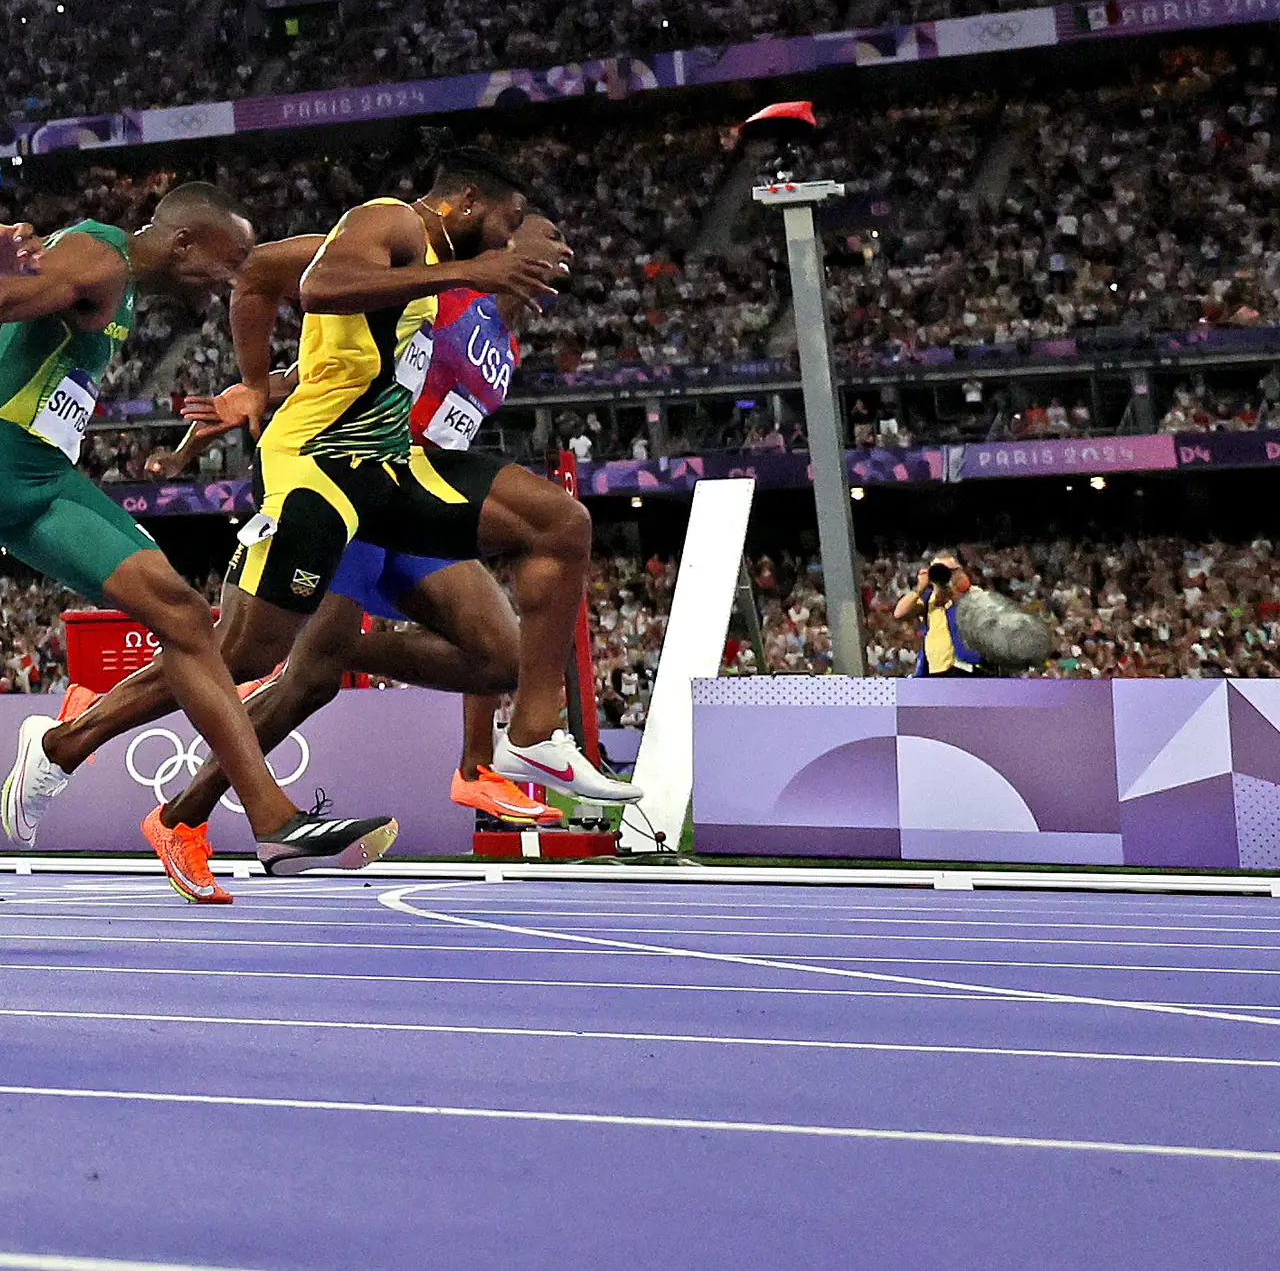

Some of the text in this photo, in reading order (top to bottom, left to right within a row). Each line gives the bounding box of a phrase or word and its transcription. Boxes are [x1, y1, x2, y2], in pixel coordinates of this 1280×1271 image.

[283, 90, 425, 120] PARIS 2024
[468, 325, 509, 401] USA
[979, 446, 1135, 466] PARIS 2024
